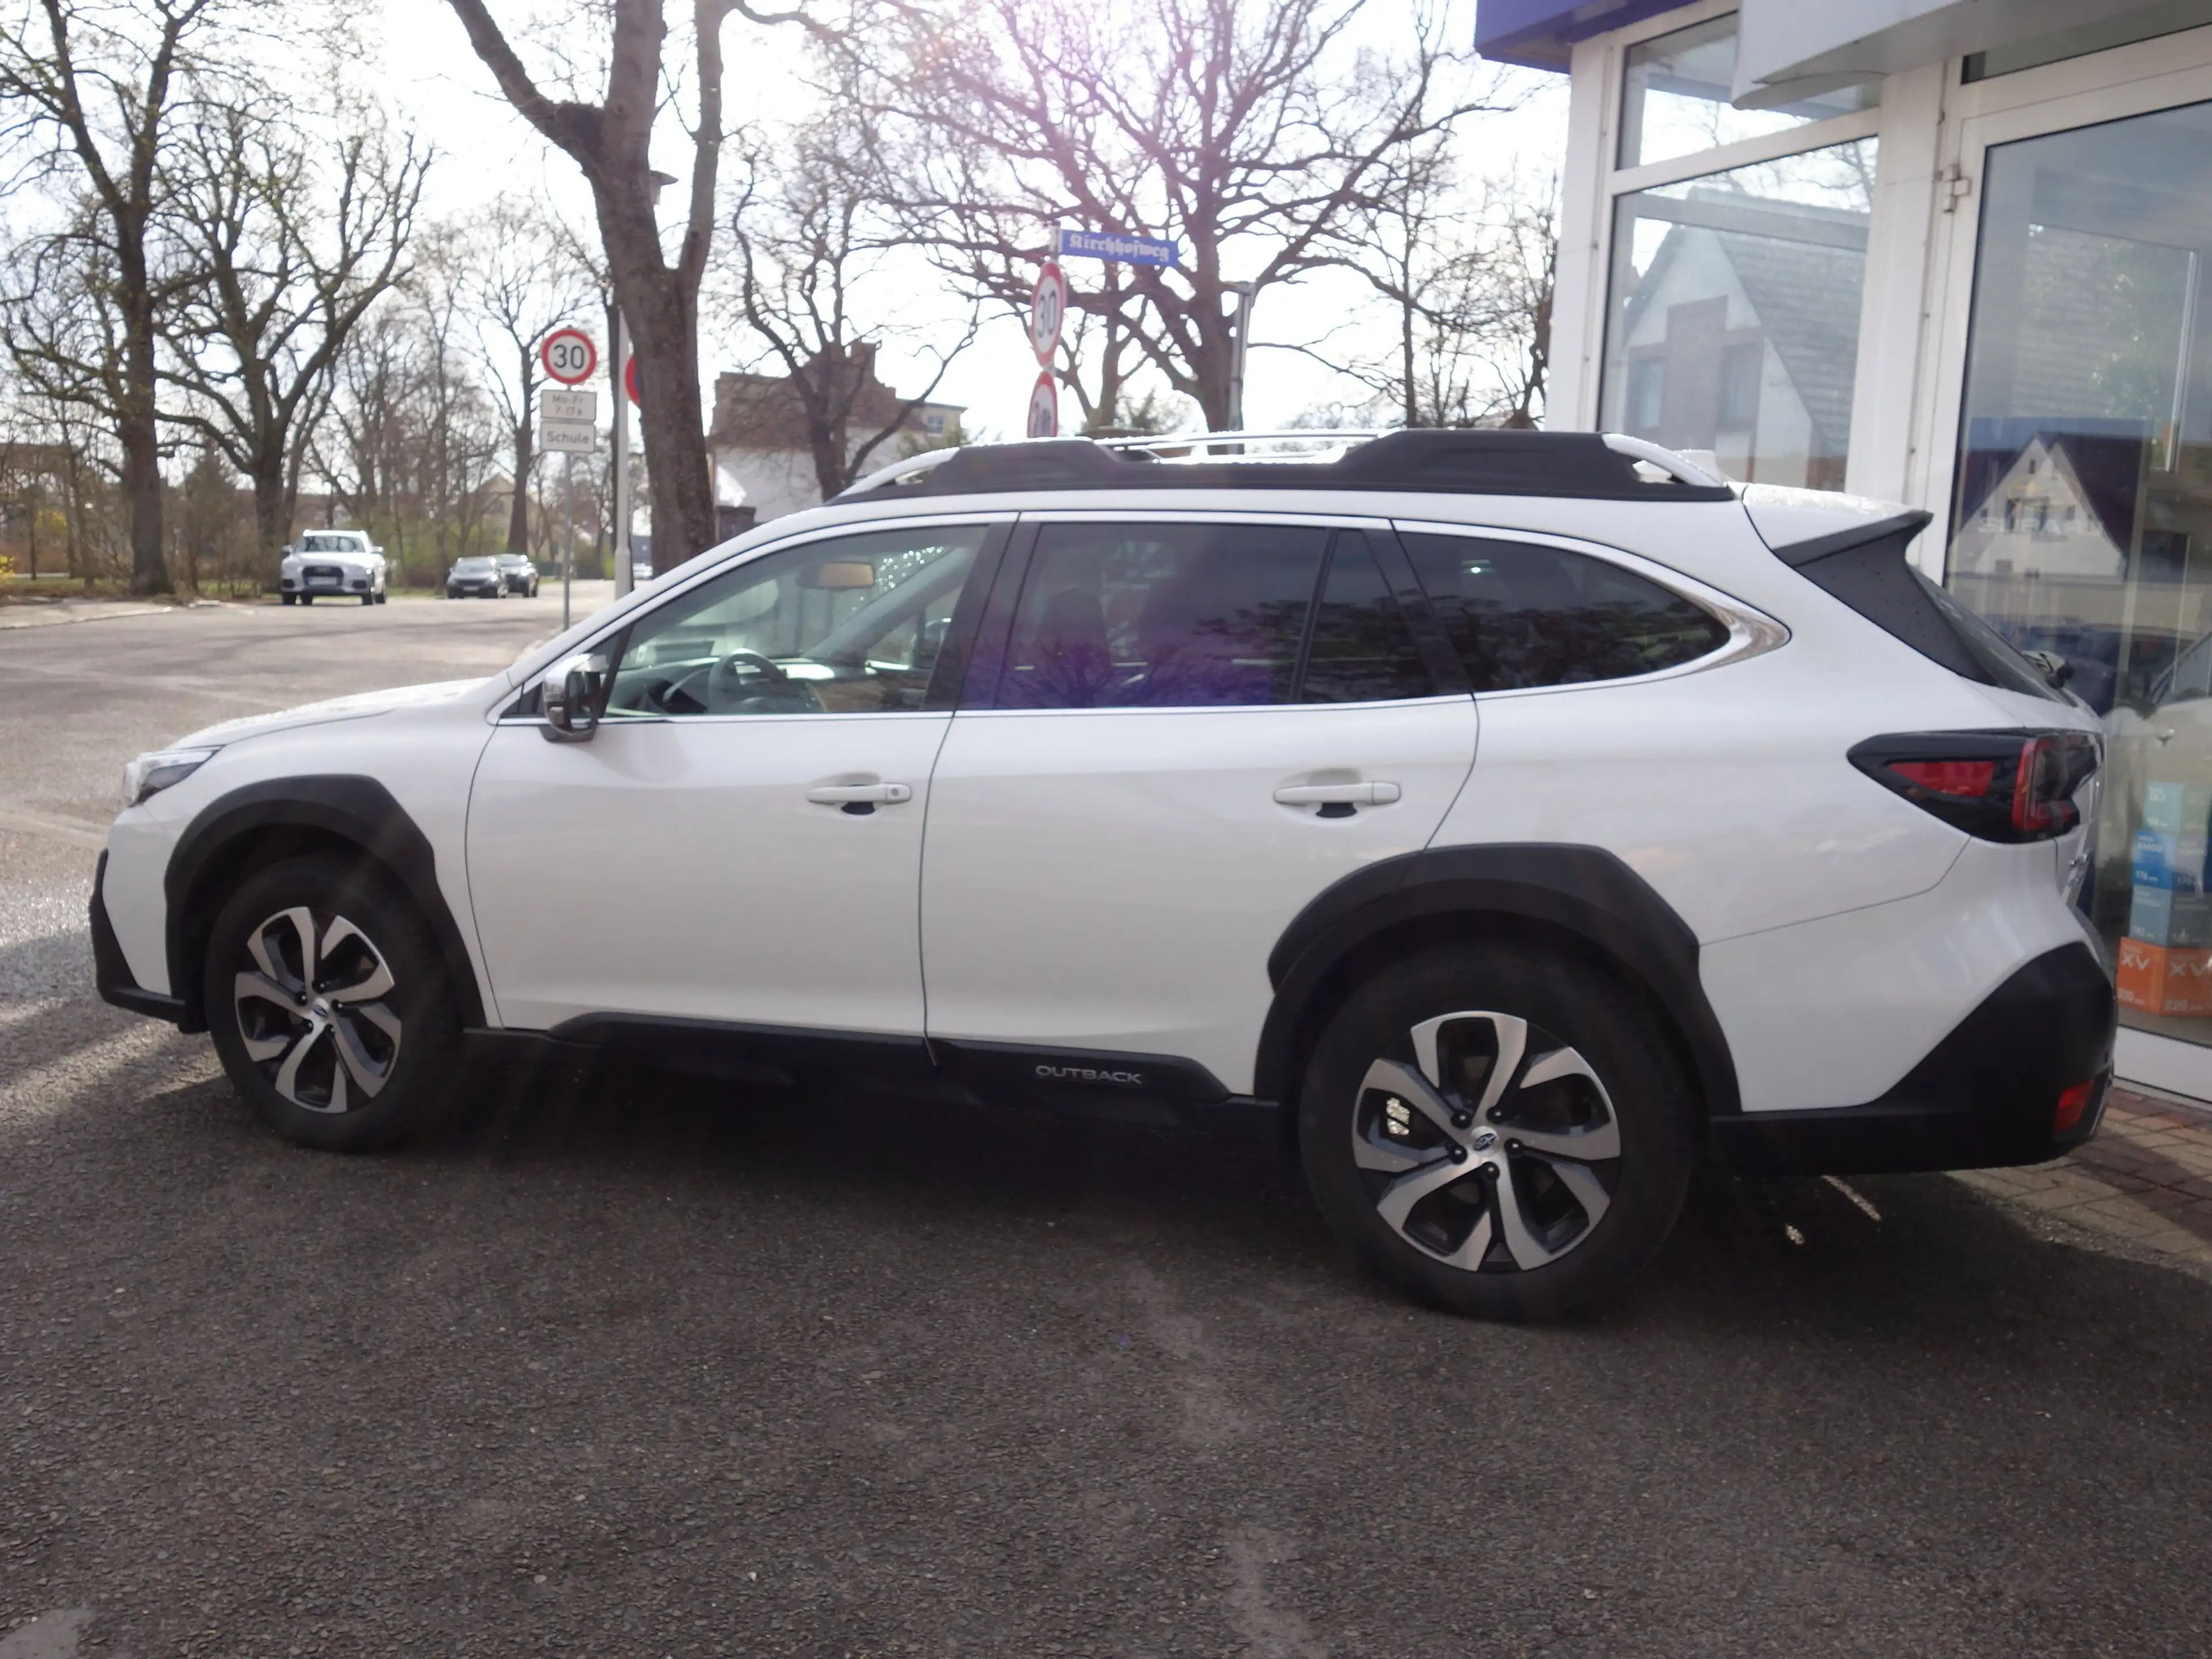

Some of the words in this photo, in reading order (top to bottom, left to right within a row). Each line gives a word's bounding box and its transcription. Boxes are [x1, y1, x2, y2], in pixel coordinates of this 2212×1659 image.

[1069, 233, 1169, 263] Kirchhofweg
[1037, 290, 1056, 339] 30
[554, 344, 584, 369] 30
[547, 430, 589, 444] Schule
[2122, 952, 2149, 971] XV
[1036, 1065, 1142, 1085] OUTBACK
